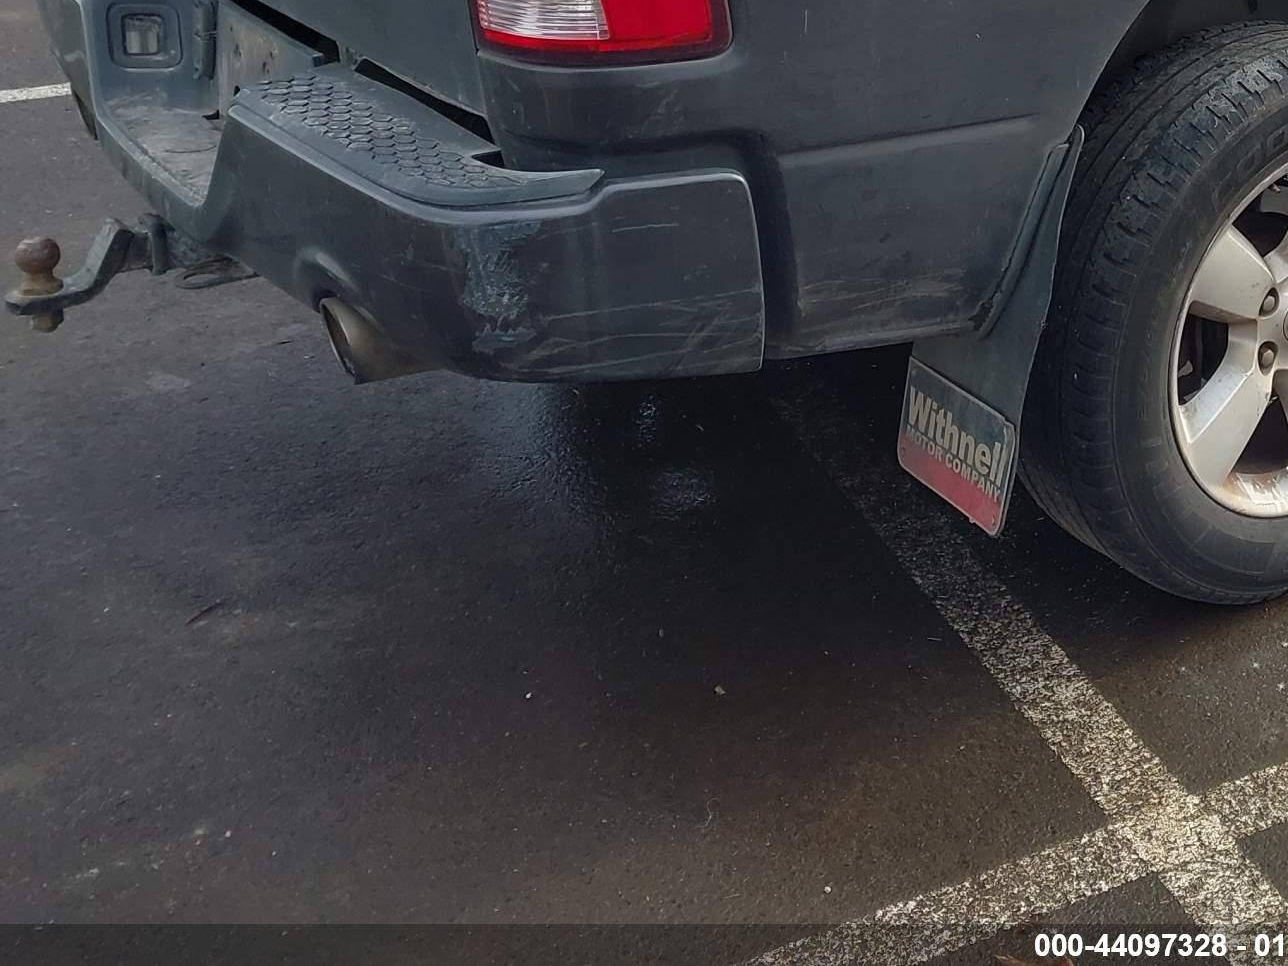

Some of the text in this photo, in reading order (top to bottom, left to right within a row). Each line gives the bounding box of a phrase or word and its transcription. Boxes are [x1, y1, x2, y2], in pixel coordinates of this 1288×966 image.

[906, 425, 1001, 503] MOTOR COMPANY
[908, 386, 1007, 485] Withnell
